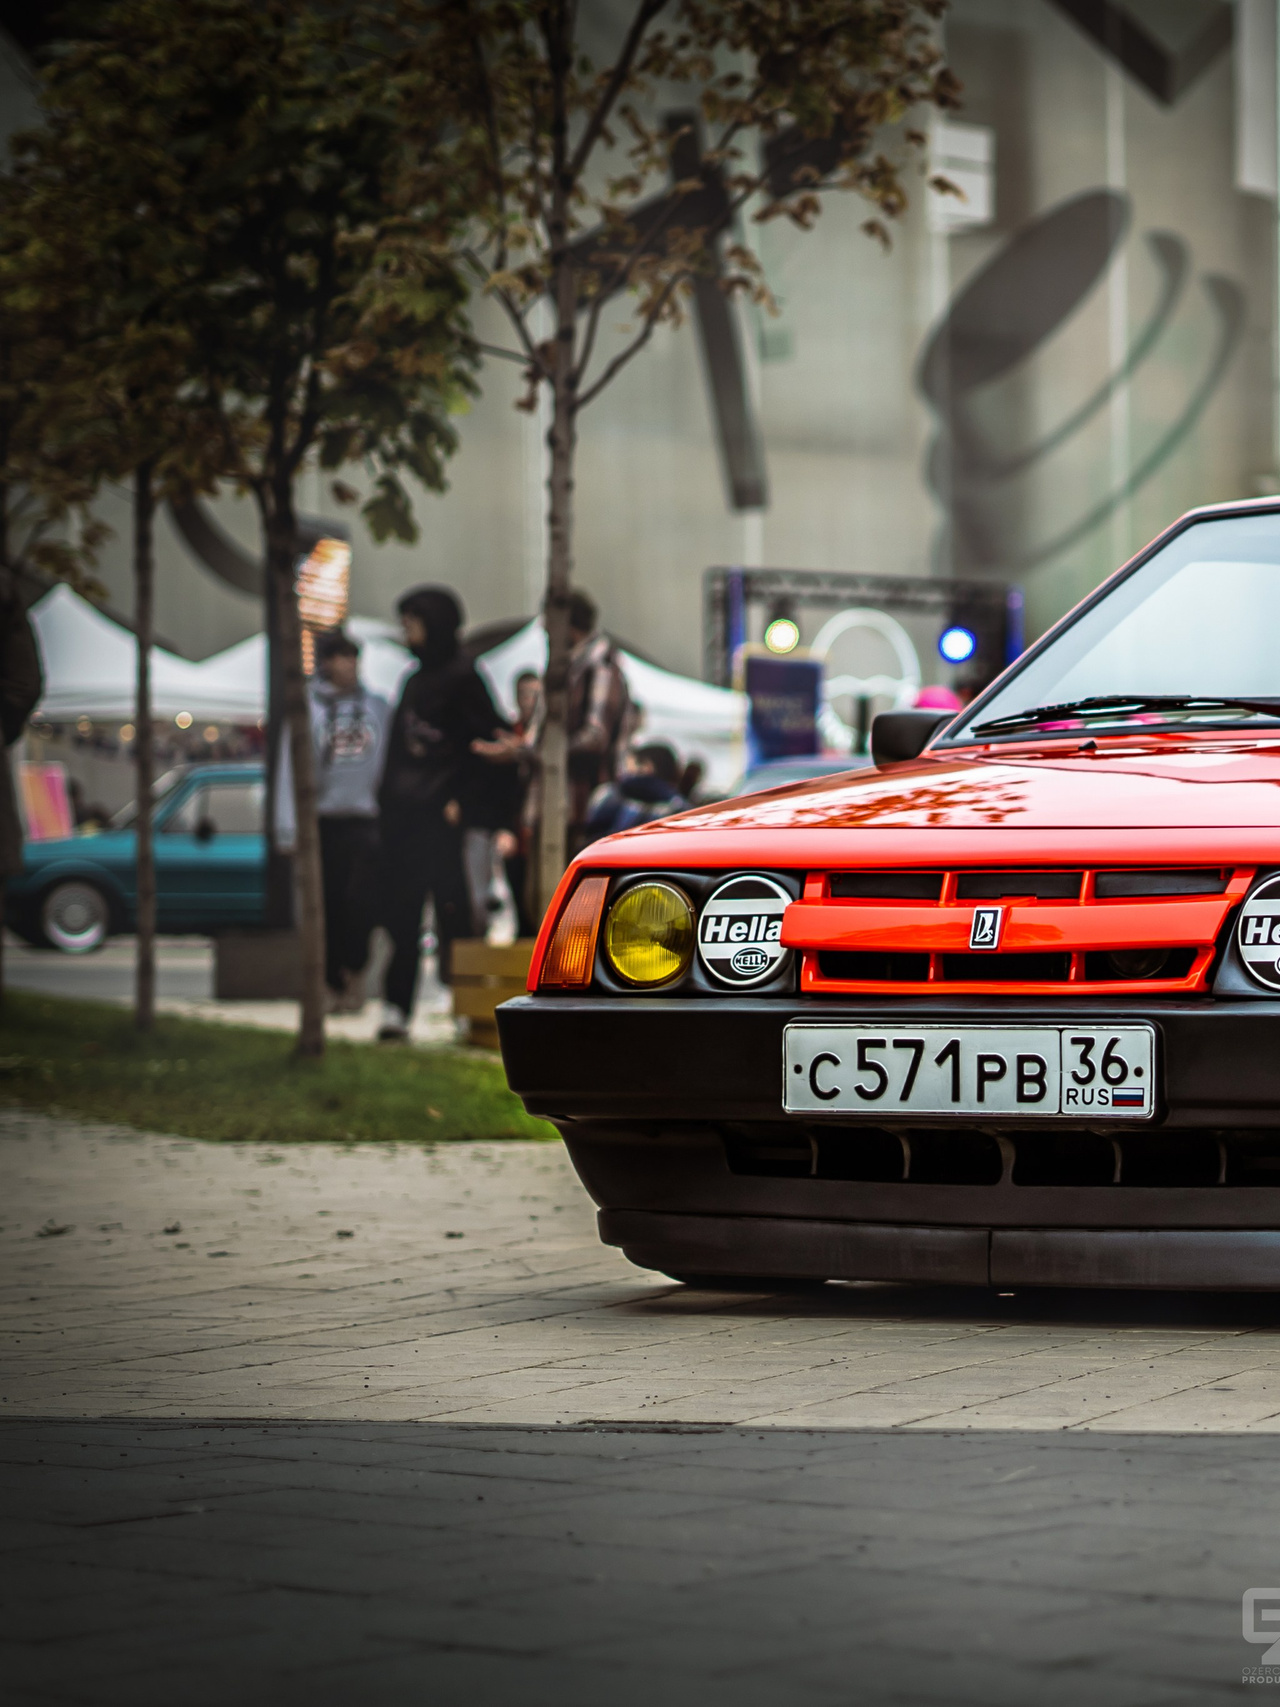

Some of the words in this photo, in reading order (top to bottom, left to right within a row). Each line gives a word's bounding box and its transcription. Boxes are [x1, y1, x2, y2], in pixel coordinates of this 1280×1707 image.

[704, 916, 783, 942] Hella
[735, 954, 768, 966] HELLA
[1070, 1037, 1129, 1085] 36
[1066, 1087, 1110, 1106] RUS
